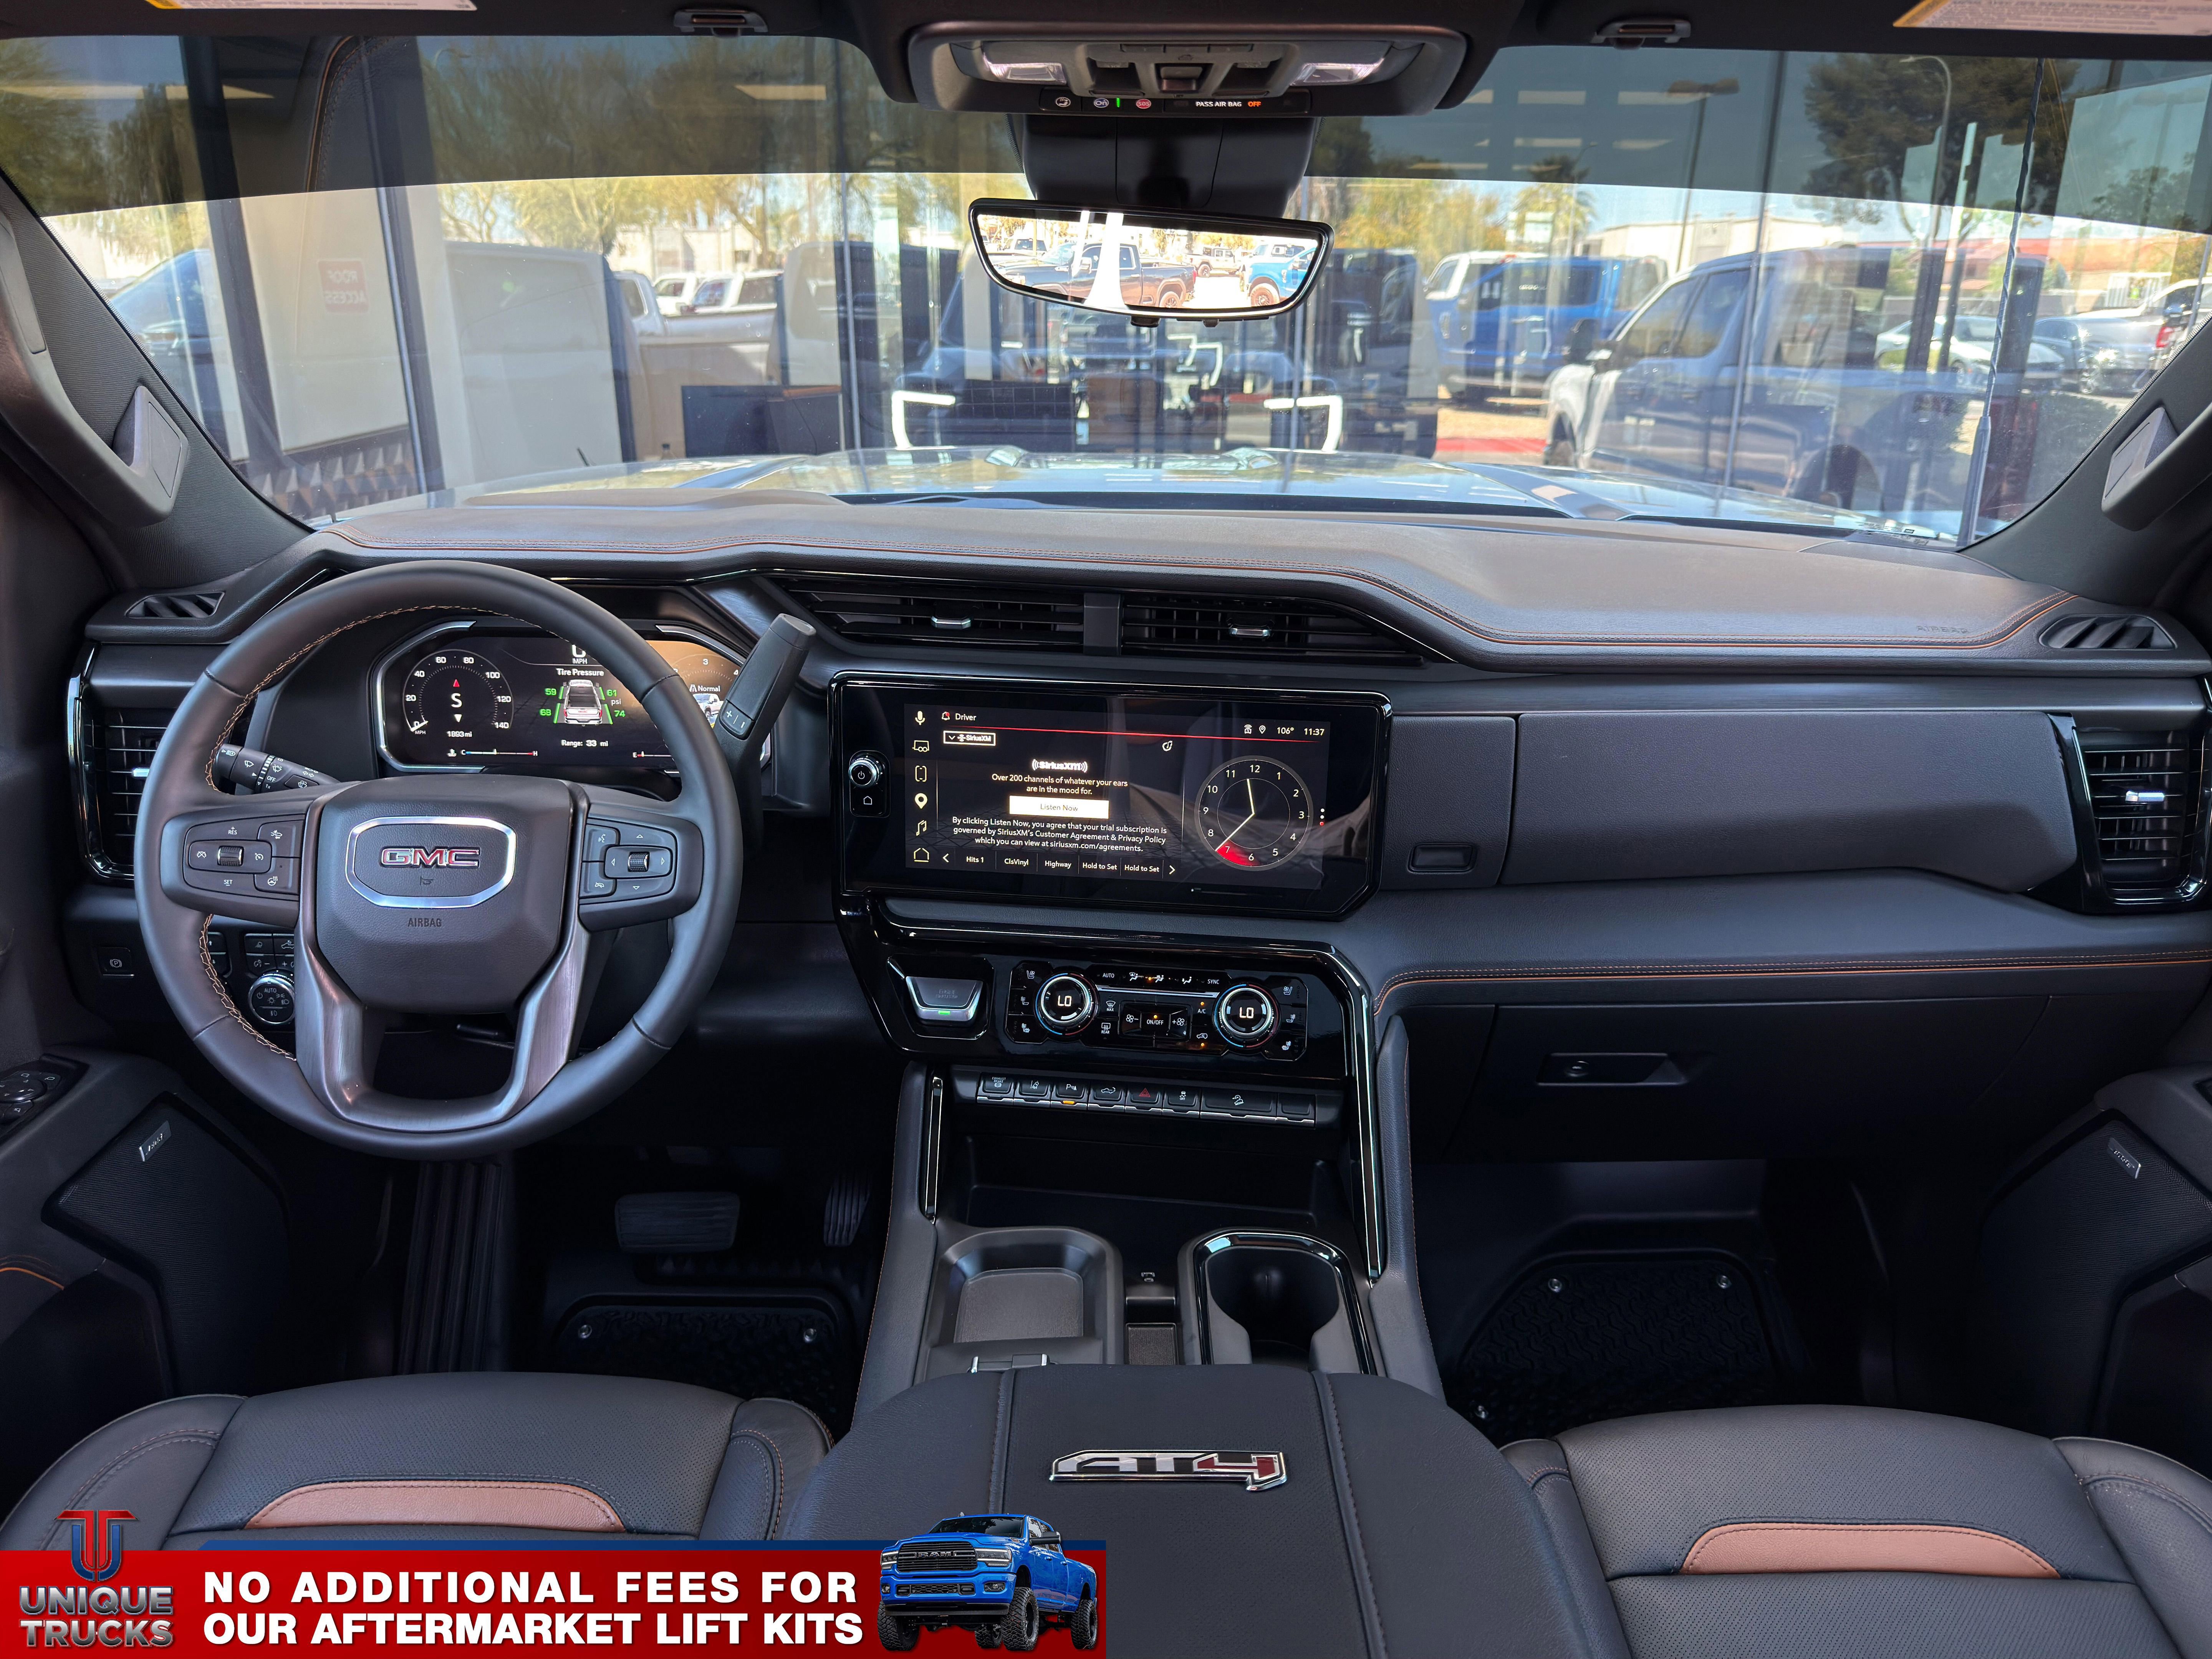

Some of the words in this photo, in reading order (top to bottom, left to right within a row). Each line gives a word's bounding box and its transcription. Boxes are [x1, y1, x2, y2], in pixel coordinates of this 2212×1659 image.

[572, 669, 604, 677] Pressure
[450, 692, 462, 708] S
[1250, 765, 1260, 773] 12
[1226, 770, 1235, 778] 11
[1277, 772, 1281, 780] 1
[1024, 775, 1054, 783] channels
[1064, 777, 1095, 785] whatever
[1207, 785, 1218, 793] 10
[952, 816, 961, 825] By
[962, 817, 988, 826] clicking
[1013, 820, 1030, 828] Now,
[1116, 825, 1159, 834] subscription
[997, 828, 1033, 836] SiriusXM's
[1070, 832, 1109, 841] Agreement
[1118, 835, 1143, 844] Privacy
[1144, 836, 1166, 845] Policy
[1050, 841, 1143, 852] siriusxm.com/agreements.
[1272, 848, 1278, 856] 5
[381, 848, 479, 867] GMC
[1004, 858, 1029, 867] ClsVinyl
[1045, 861, 1071, 869] Highway
[408, 918, 442, 927] AIRBAG
[1058, 995, 1072, 1007] LO
[1239, 1007, 1254, 1019] LO
[1054, 1451, 1283, 1485] AT4
